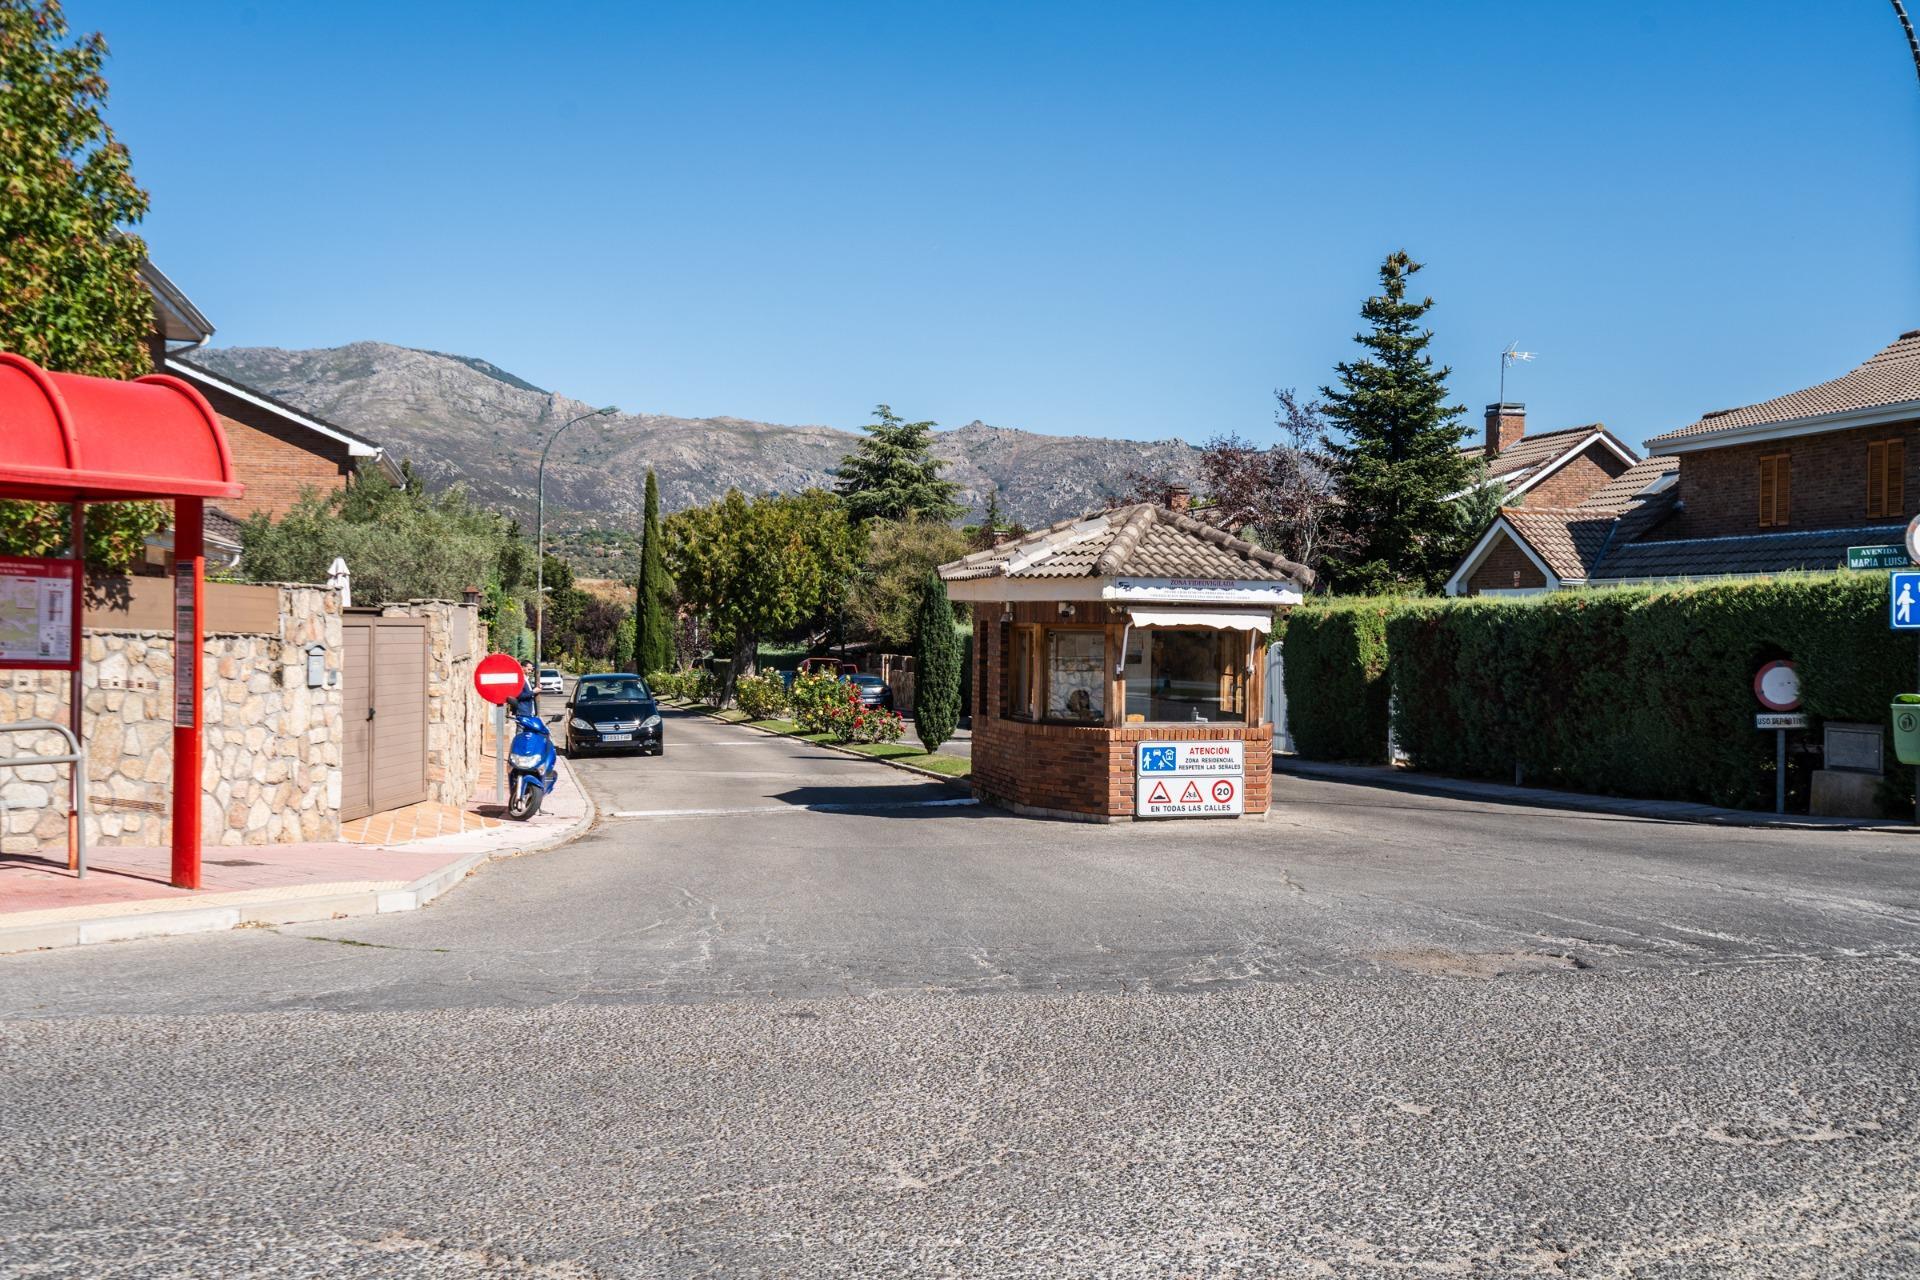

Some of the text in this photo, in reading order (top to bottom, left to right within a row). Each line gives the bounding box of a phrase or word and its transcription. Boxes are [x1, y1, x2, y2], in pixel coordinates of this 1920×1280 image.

[1860, 548, 1898, 556] AVENIDA
[1883, 556, 1909, 567] LUISA
[1216, 787, 1230, 796] 20
[1188, 804, 1202, 812] LAS
